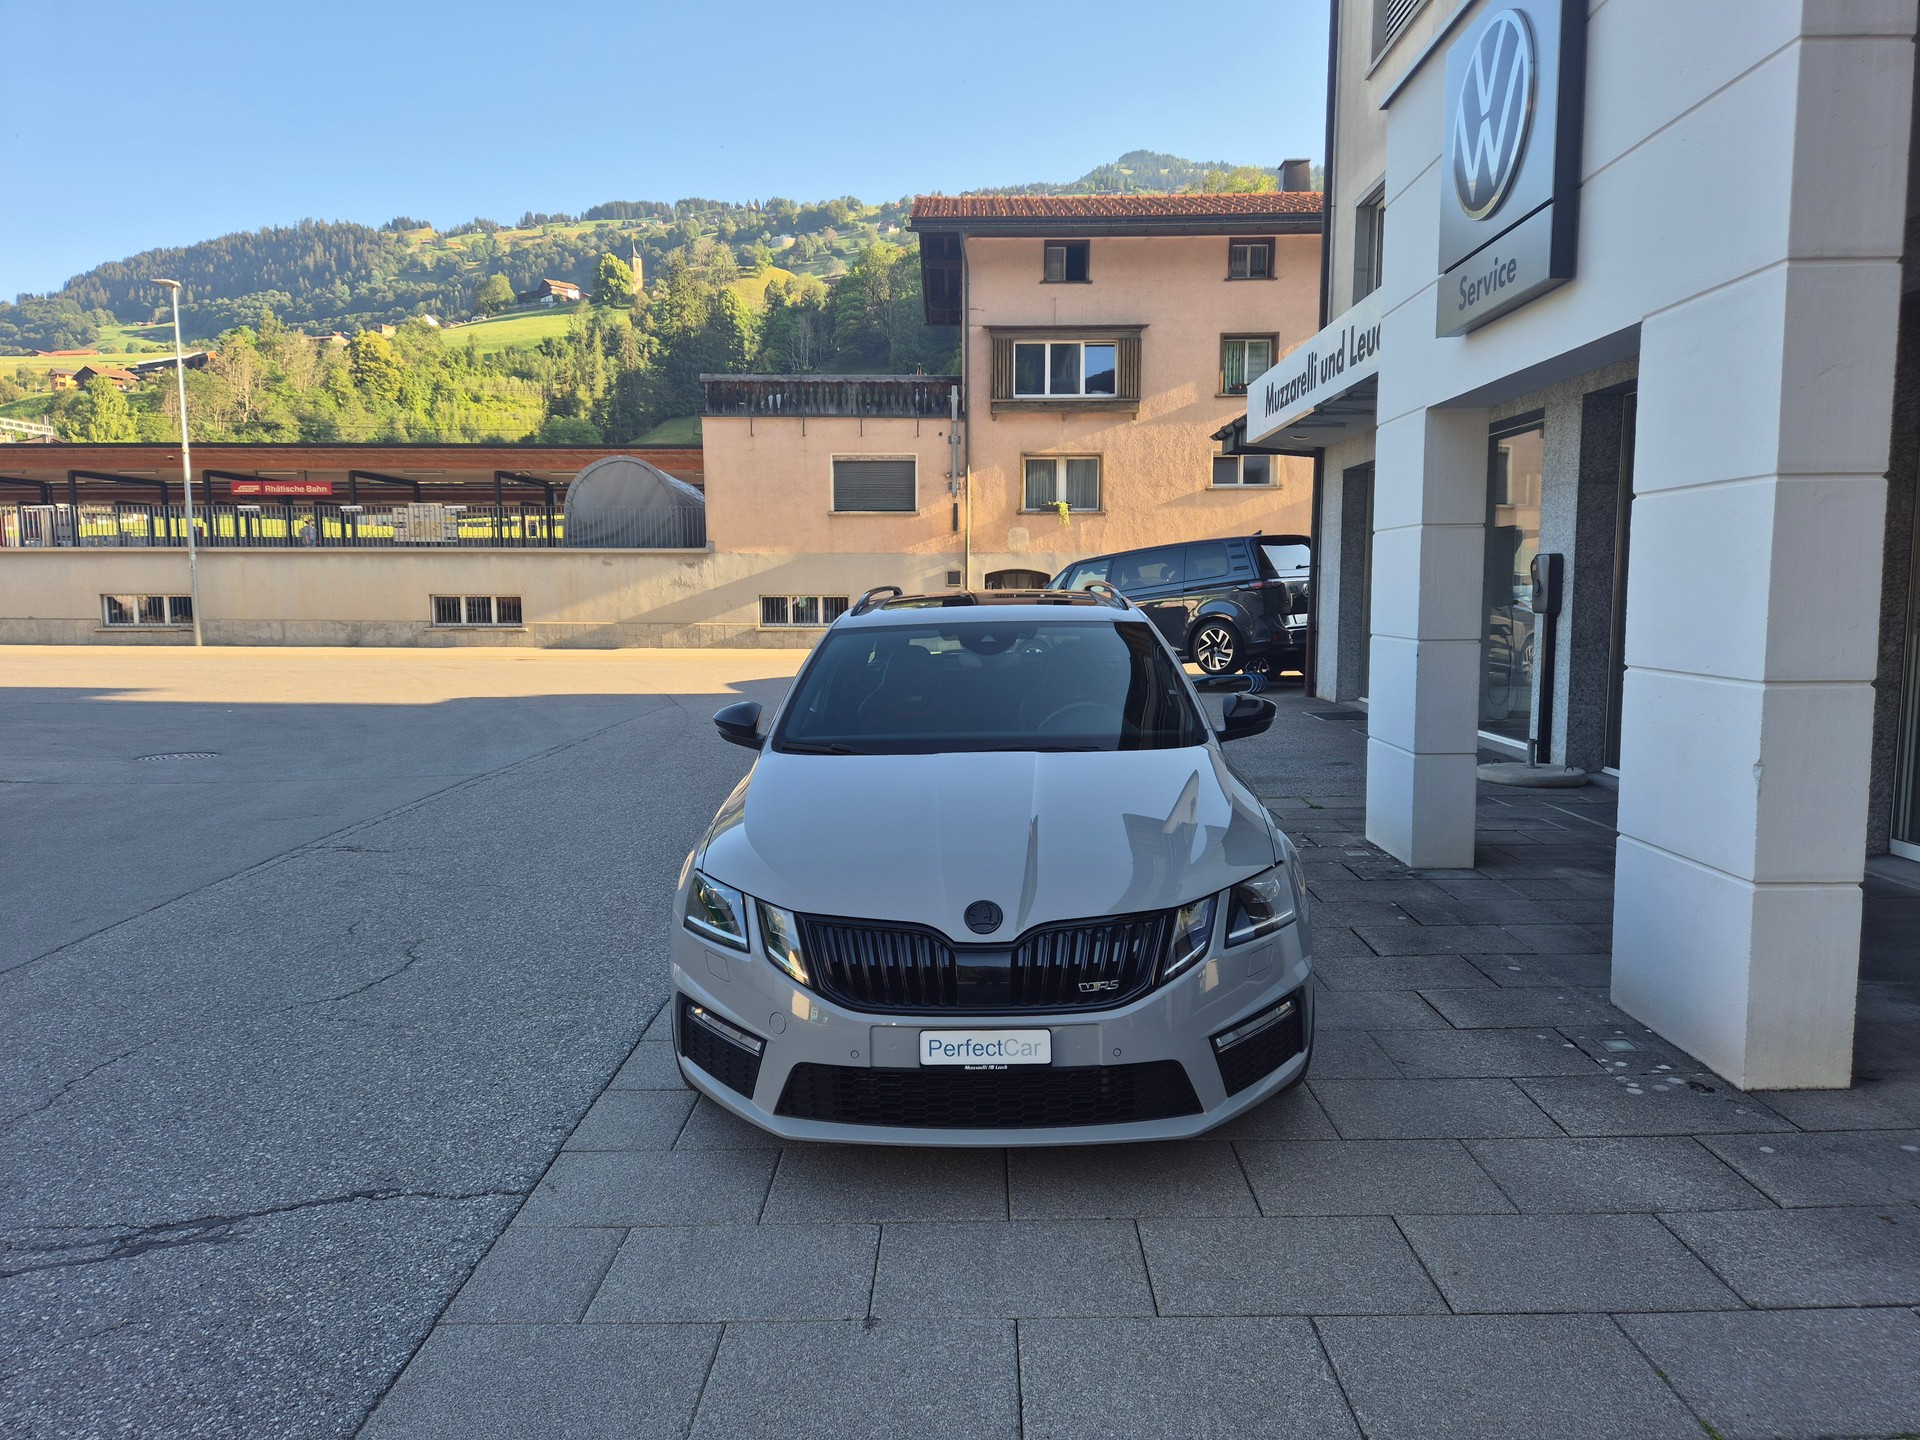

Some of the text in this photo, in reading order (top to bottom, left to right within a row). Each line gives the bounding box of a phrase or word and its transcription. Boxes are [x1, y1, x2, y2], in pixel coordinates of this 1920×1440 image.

[1459, 257, 1517, 311] Service
[1265, 352, 1317, 418] Muzzarelli
[1320, 329, 1345, 384] und
[264, 485, 327, 493] Rhätische Bahn
[929, 1039, 1041, 1057] PerfectCar
